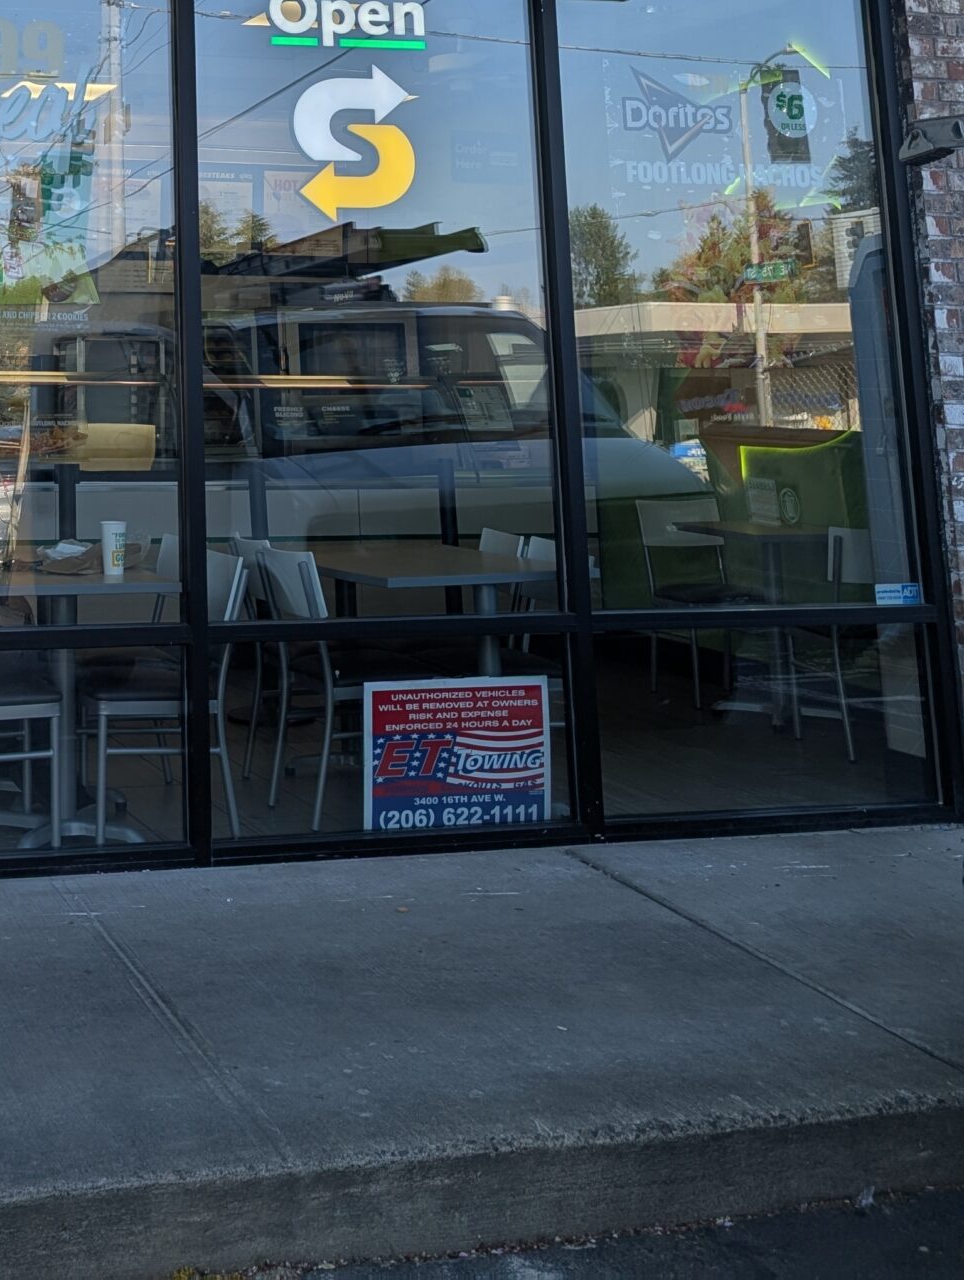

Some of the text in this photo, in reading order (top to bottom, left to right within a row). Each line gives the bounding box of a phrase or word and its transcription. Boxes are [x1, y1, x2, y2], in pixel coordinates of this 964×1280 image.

[776, 92, 804, 120] $6
[624, 99, 731, 132] Doritos
[455, 143, 487, 154] Order
[626, 160, 735, 184] FOOTLONG
[274, 179, 299, 192] HOT
[57, 312, 89, 322] COOKIES
[391, 689, 526, 701] UNAUTHORIZED VEHICLES
[378, 704, 403, 712] WILL
[405, 703, 419, 711] BE
[422, 701, 474, 709] REMOVED
[492, 699, 539, 707] OWNERS
[409, 709, 509, 721] RISK AND EXPENSE
[385, 719, 533, 731] ENFORCED 24 HOURS A DAY
[374, 740, 454, 778] ET
[413, 794, 506, 805] 3400 16TH AVE W.
[379, 803, 538, 829] (206) 622-1111
